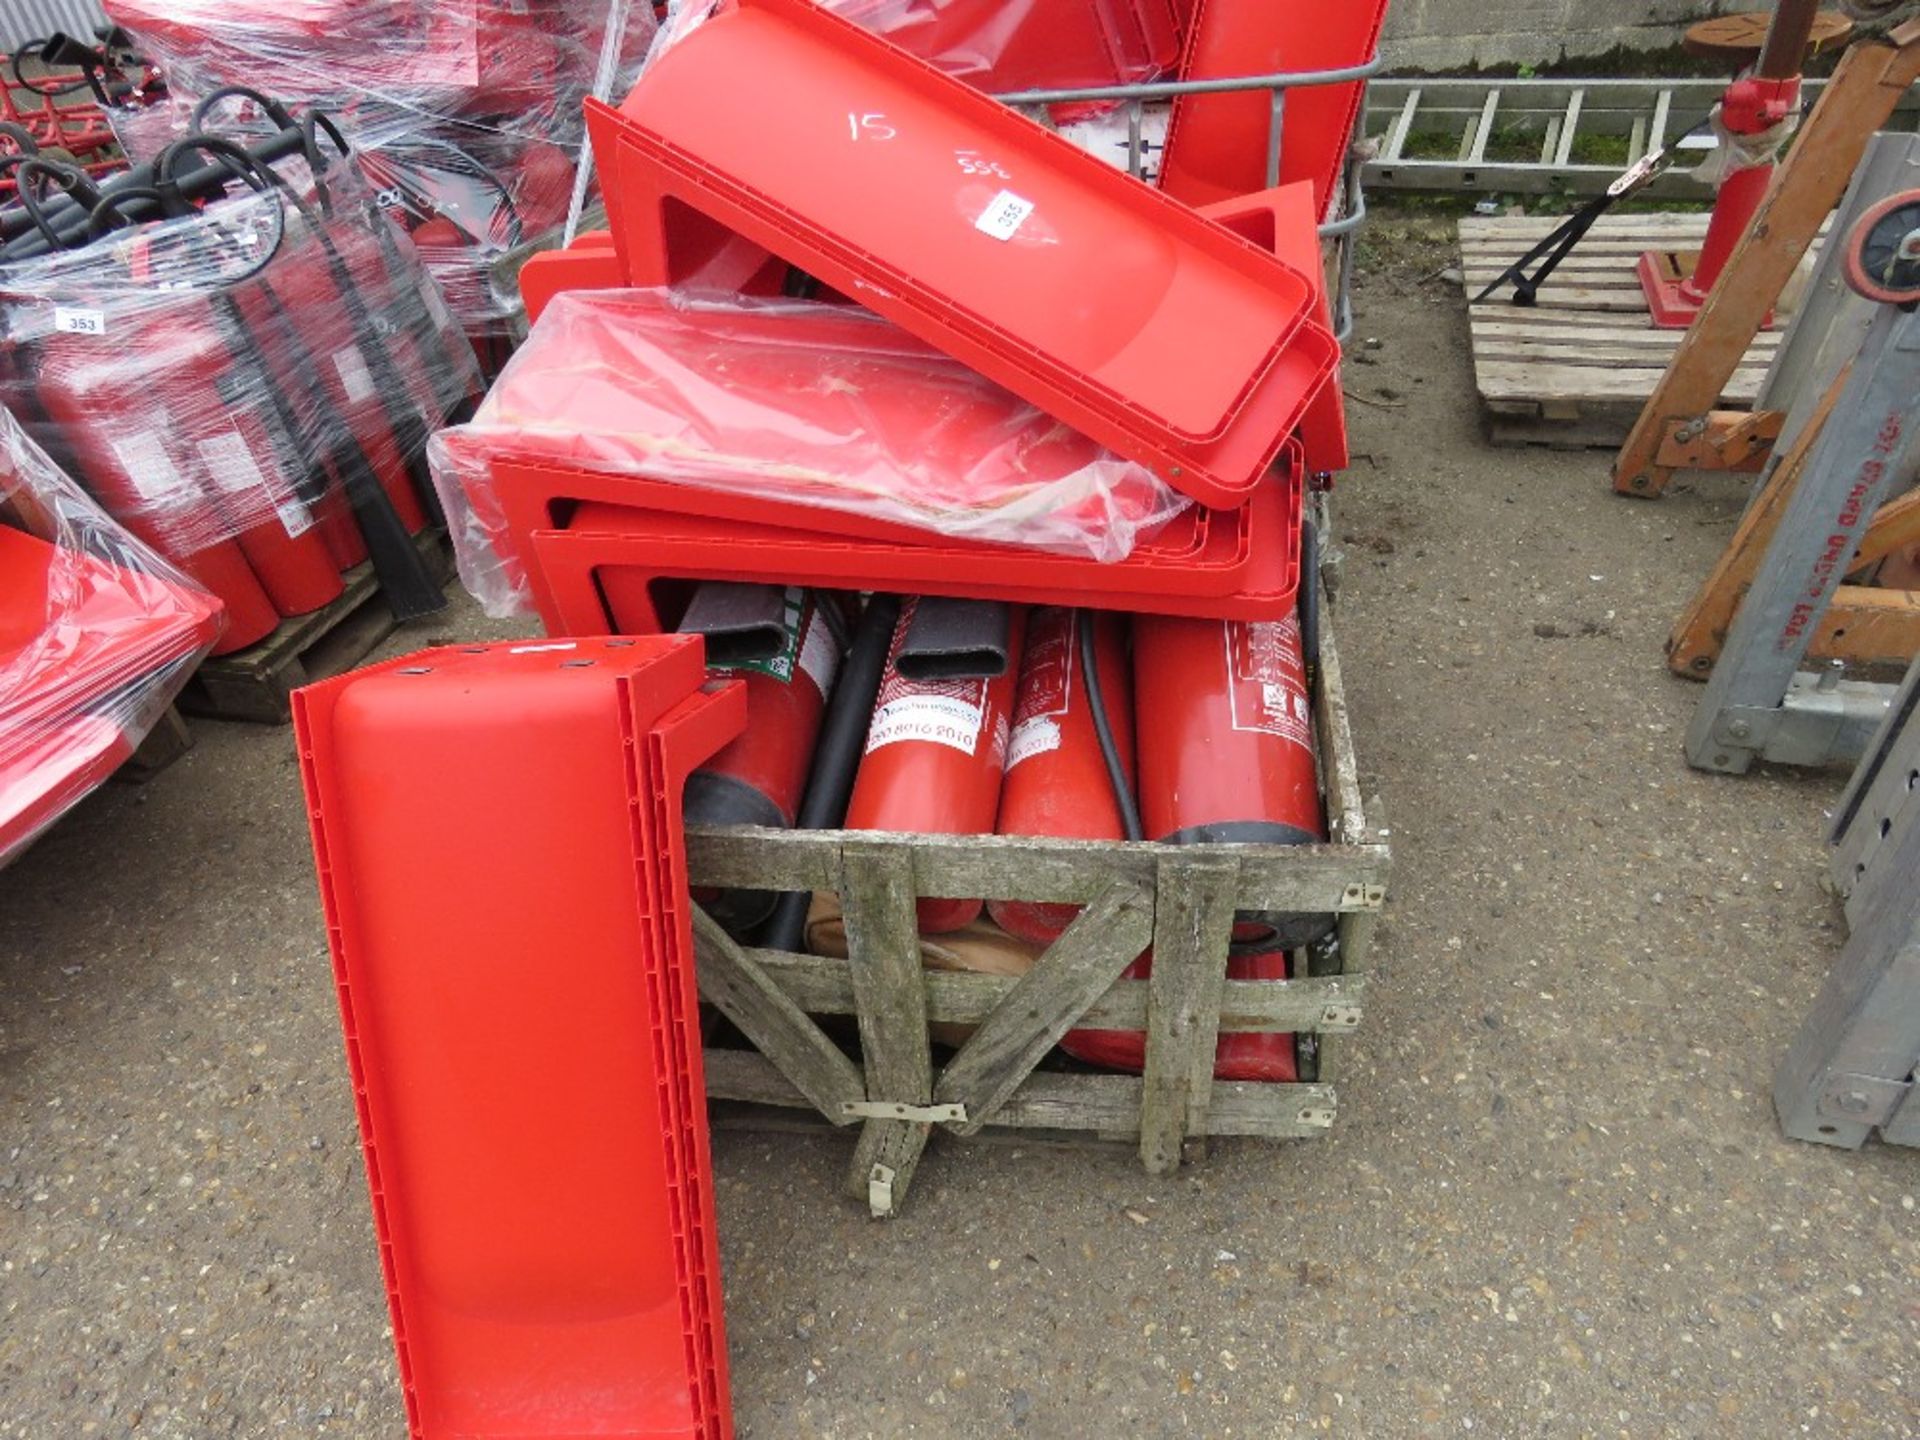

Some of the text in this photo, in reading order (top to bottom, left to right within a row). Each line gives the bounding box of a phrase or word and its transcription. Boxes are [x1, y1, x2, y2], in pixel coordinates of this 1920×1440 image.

[848, 112, 896, 141] 15
[997, 203, 1022, 227] 355
[70, 318, 96, 331] 353
[936, 724, 973, 746] 2010
